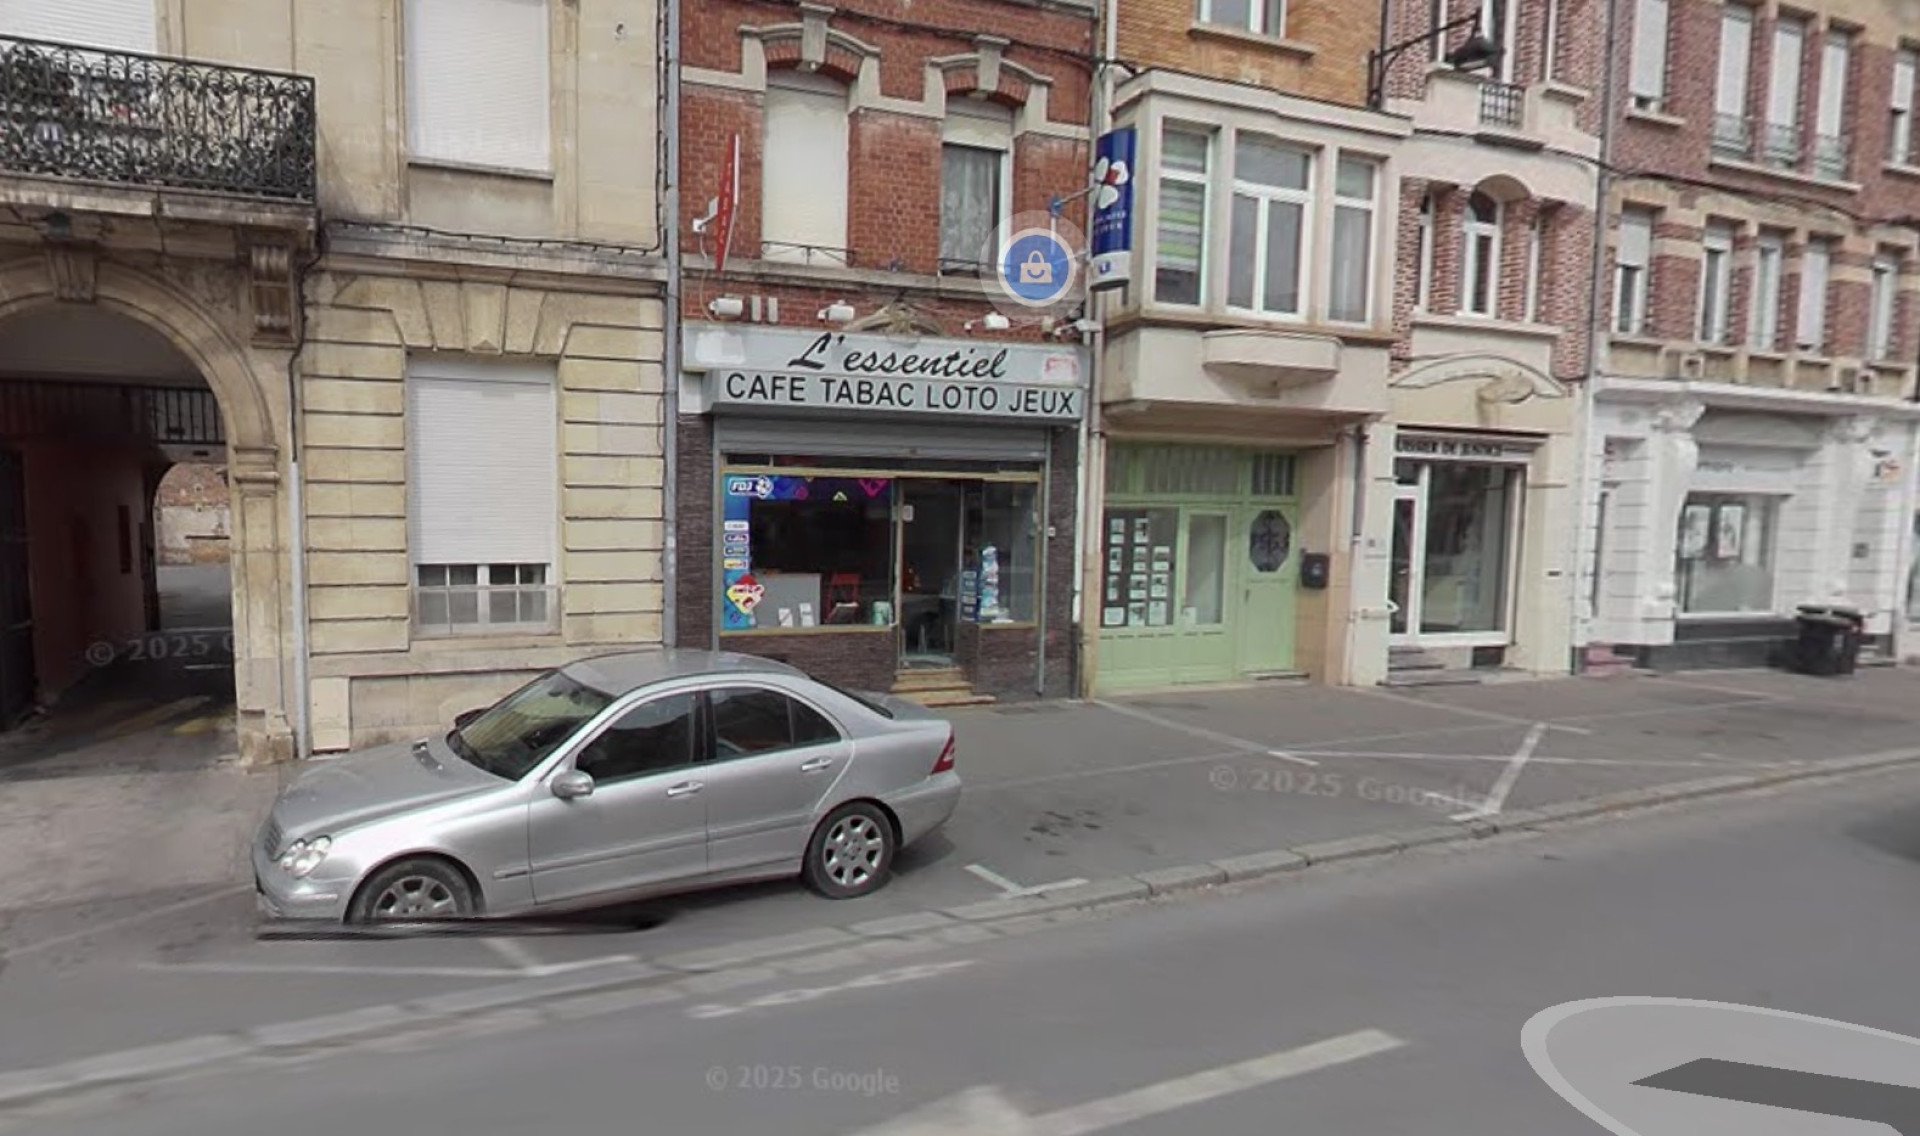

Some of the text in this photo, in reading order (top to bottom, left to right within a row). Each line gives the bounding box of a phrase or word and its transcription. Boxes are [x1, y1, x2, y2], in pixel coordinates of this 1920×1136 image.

[788, 332, 1008, 379] L'essentiel
[726, 373, 1075, 415] CAFE TABAC LOTO JEUX
